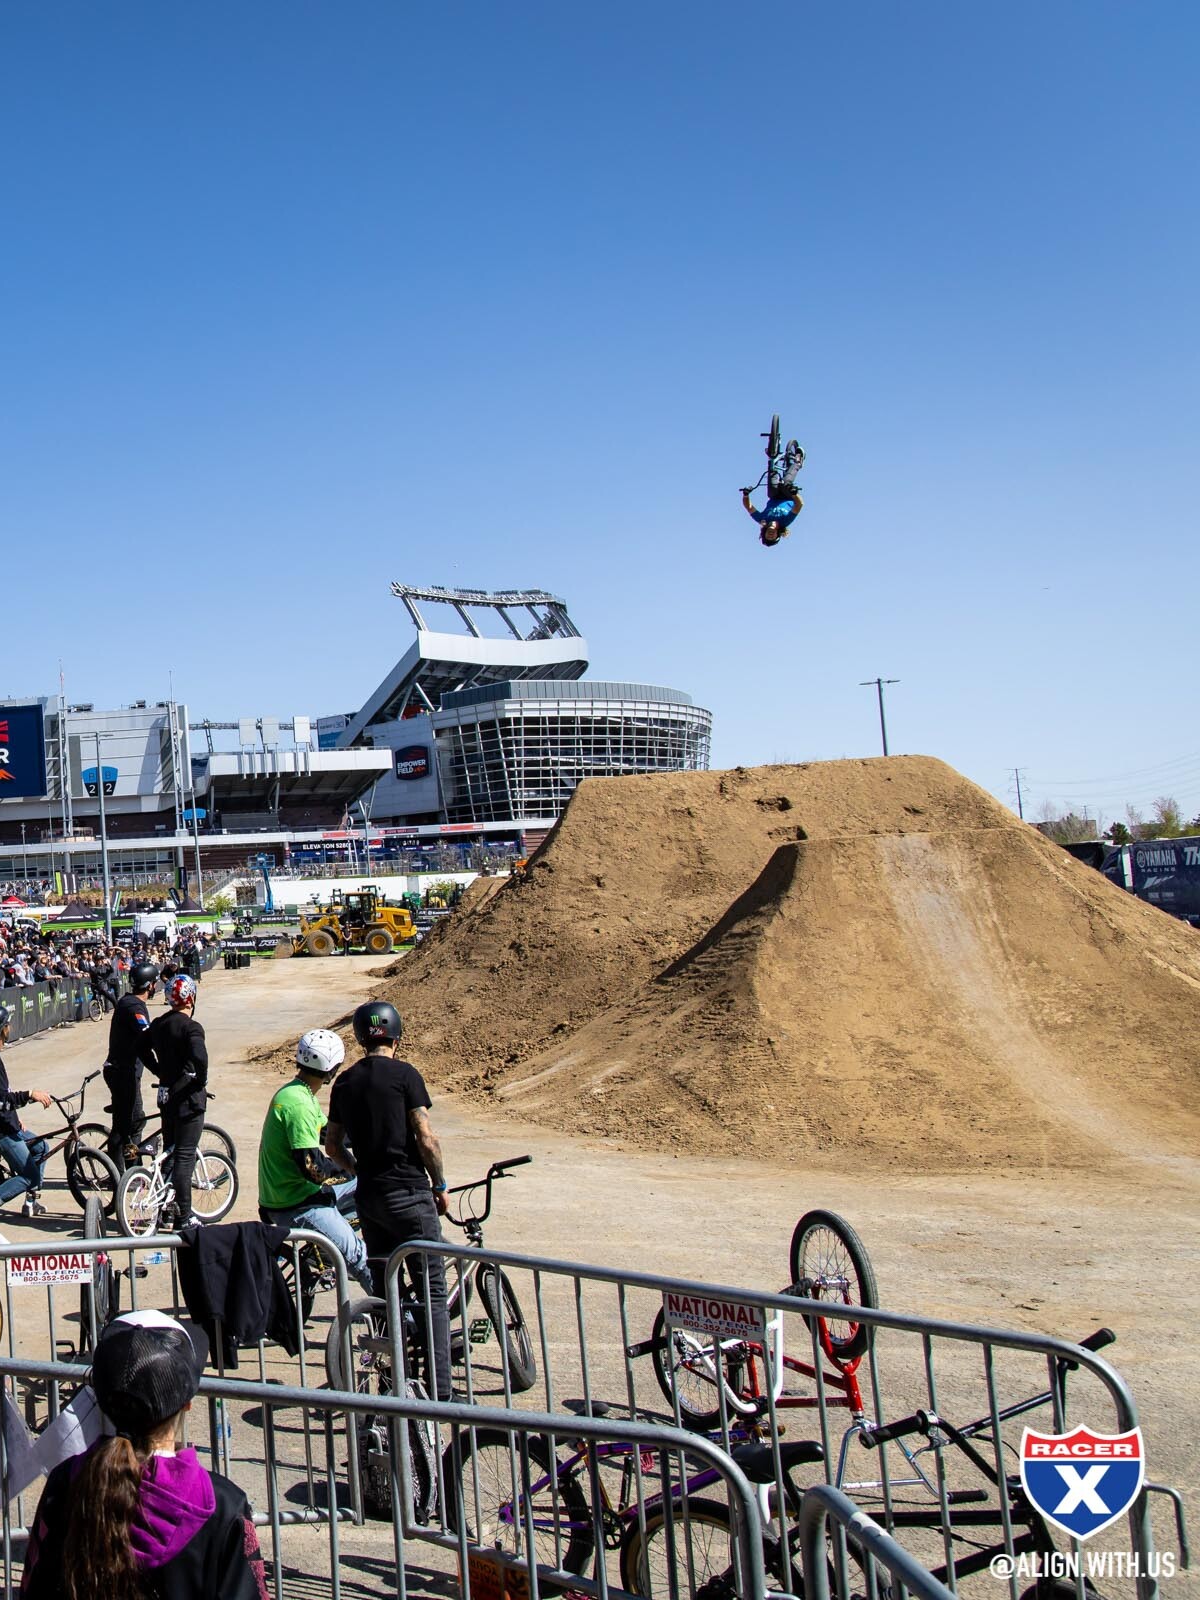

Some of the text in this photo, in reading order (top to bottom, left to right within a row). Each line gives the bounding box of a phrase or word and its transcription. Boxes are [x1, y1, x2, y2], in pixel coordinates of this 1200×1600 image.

[397, 759, 426, 769] EMPOWER
[397, 767, 414, 775] FIELD
[89, 784, 96, 794] 2
[105, 783, 113, 793] 2
[1144, 849, 1177, 867] YAMAHA
[11, 1254, 90, 1273] NATIONAL
[11, 1269, 92, 1278] RENT-A-FENCE
[23, 1274, 79, 1282] 800-352-5675
[668, 1294, 761, 1327] NATIONAL
[669, 1311, 762, 1333] RENT-A-FENCE
[682, 1319, 748, 1337] 800-352-5675
